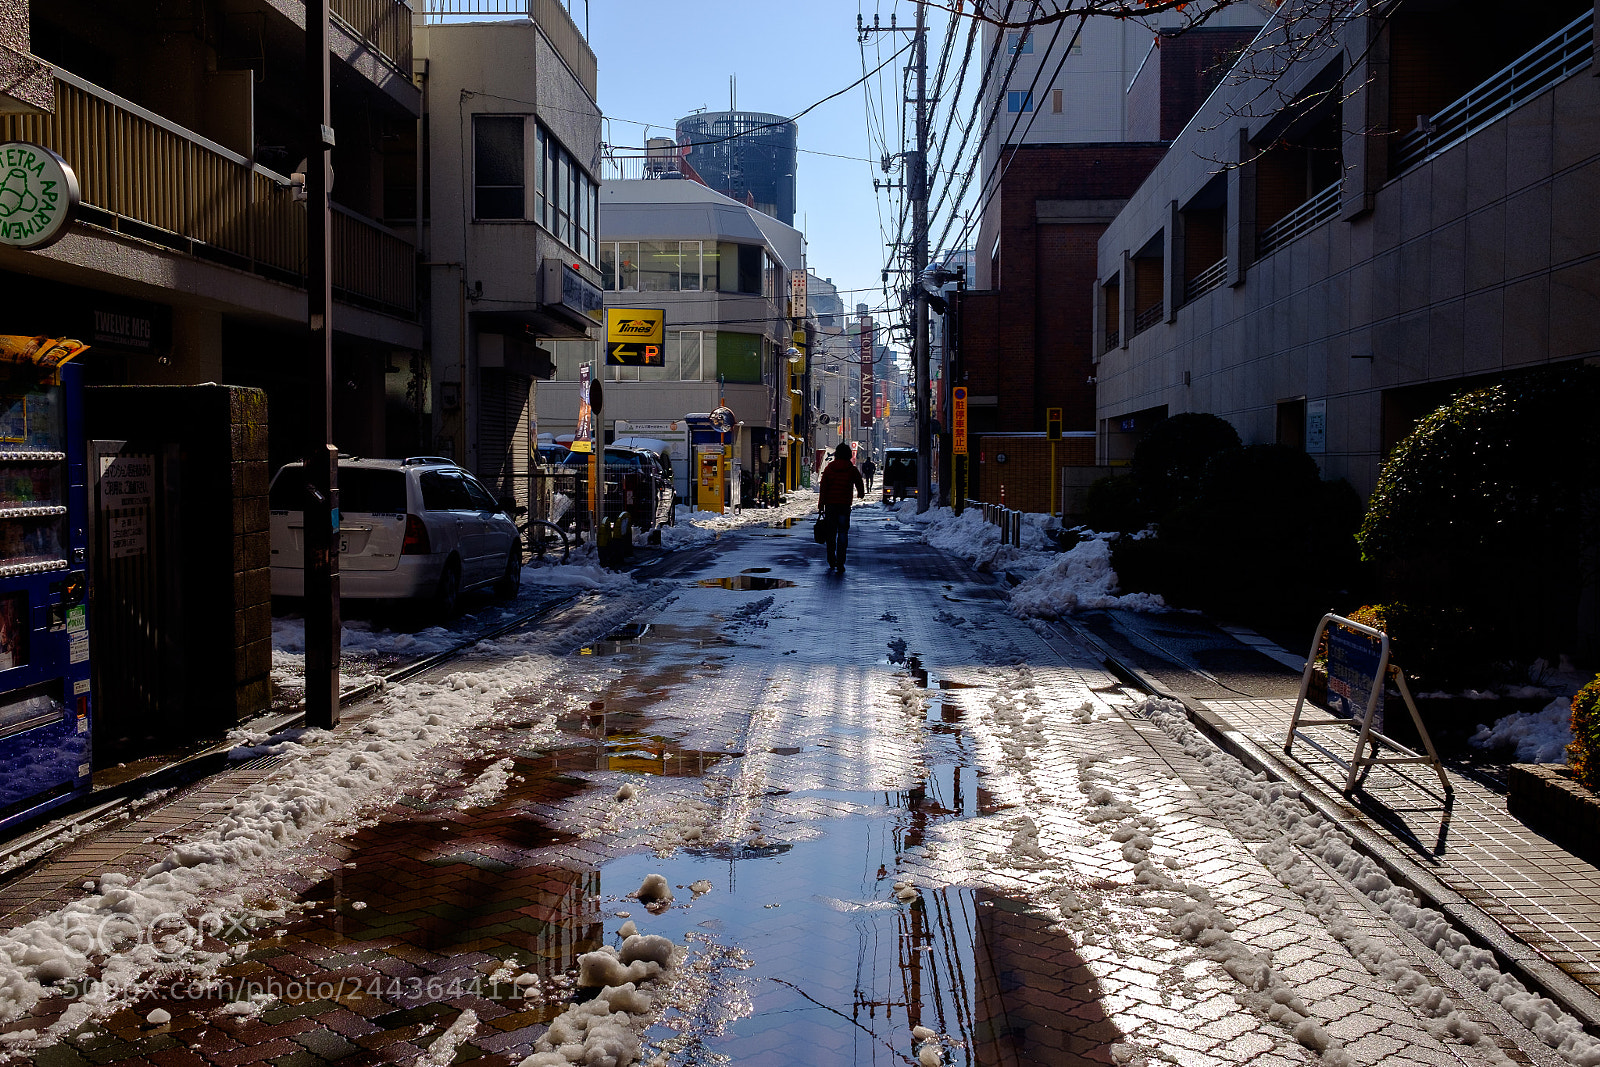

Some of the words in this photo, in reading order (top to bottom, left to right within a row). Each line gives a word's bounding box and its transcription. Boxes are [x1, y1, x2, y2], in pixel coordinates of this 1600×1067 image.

[94, 310, 130, 337] TWELVE
[131, 316, 152, 340] MFG
[617, 320, 653, 333] Times
[645, 346, 659, 364] P
[955, 400, 965, 447] 駐停車禁止
